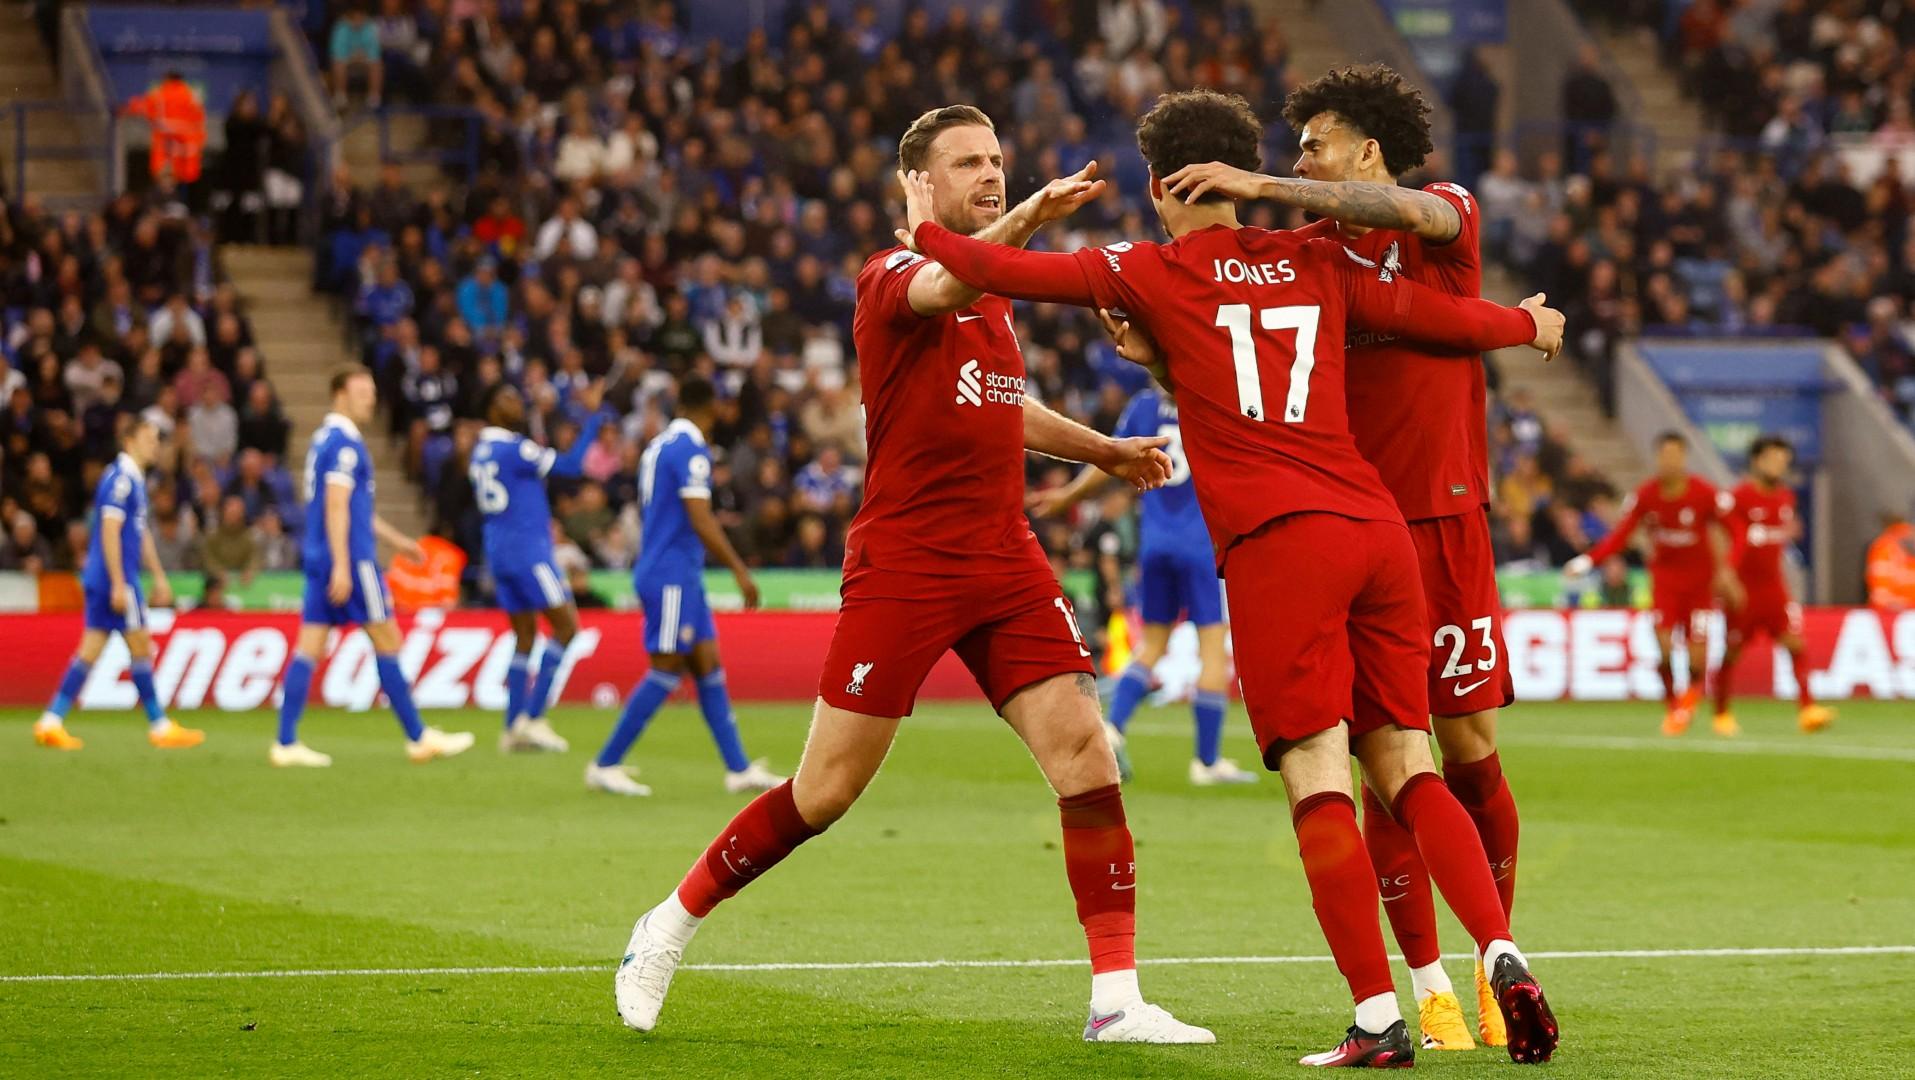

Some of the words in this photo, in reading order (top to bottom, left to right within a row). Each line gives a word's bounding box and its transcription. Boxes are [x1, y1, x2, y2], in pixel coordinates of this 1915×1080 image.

[1212, 257, 1297, 286] JONES
[1214, 303, 1321, 424] 17
[79, 606, 601, 711] Enegizer
[1433, 616, 1497, 679] 23
[845, 682, 863, 697] LFC
